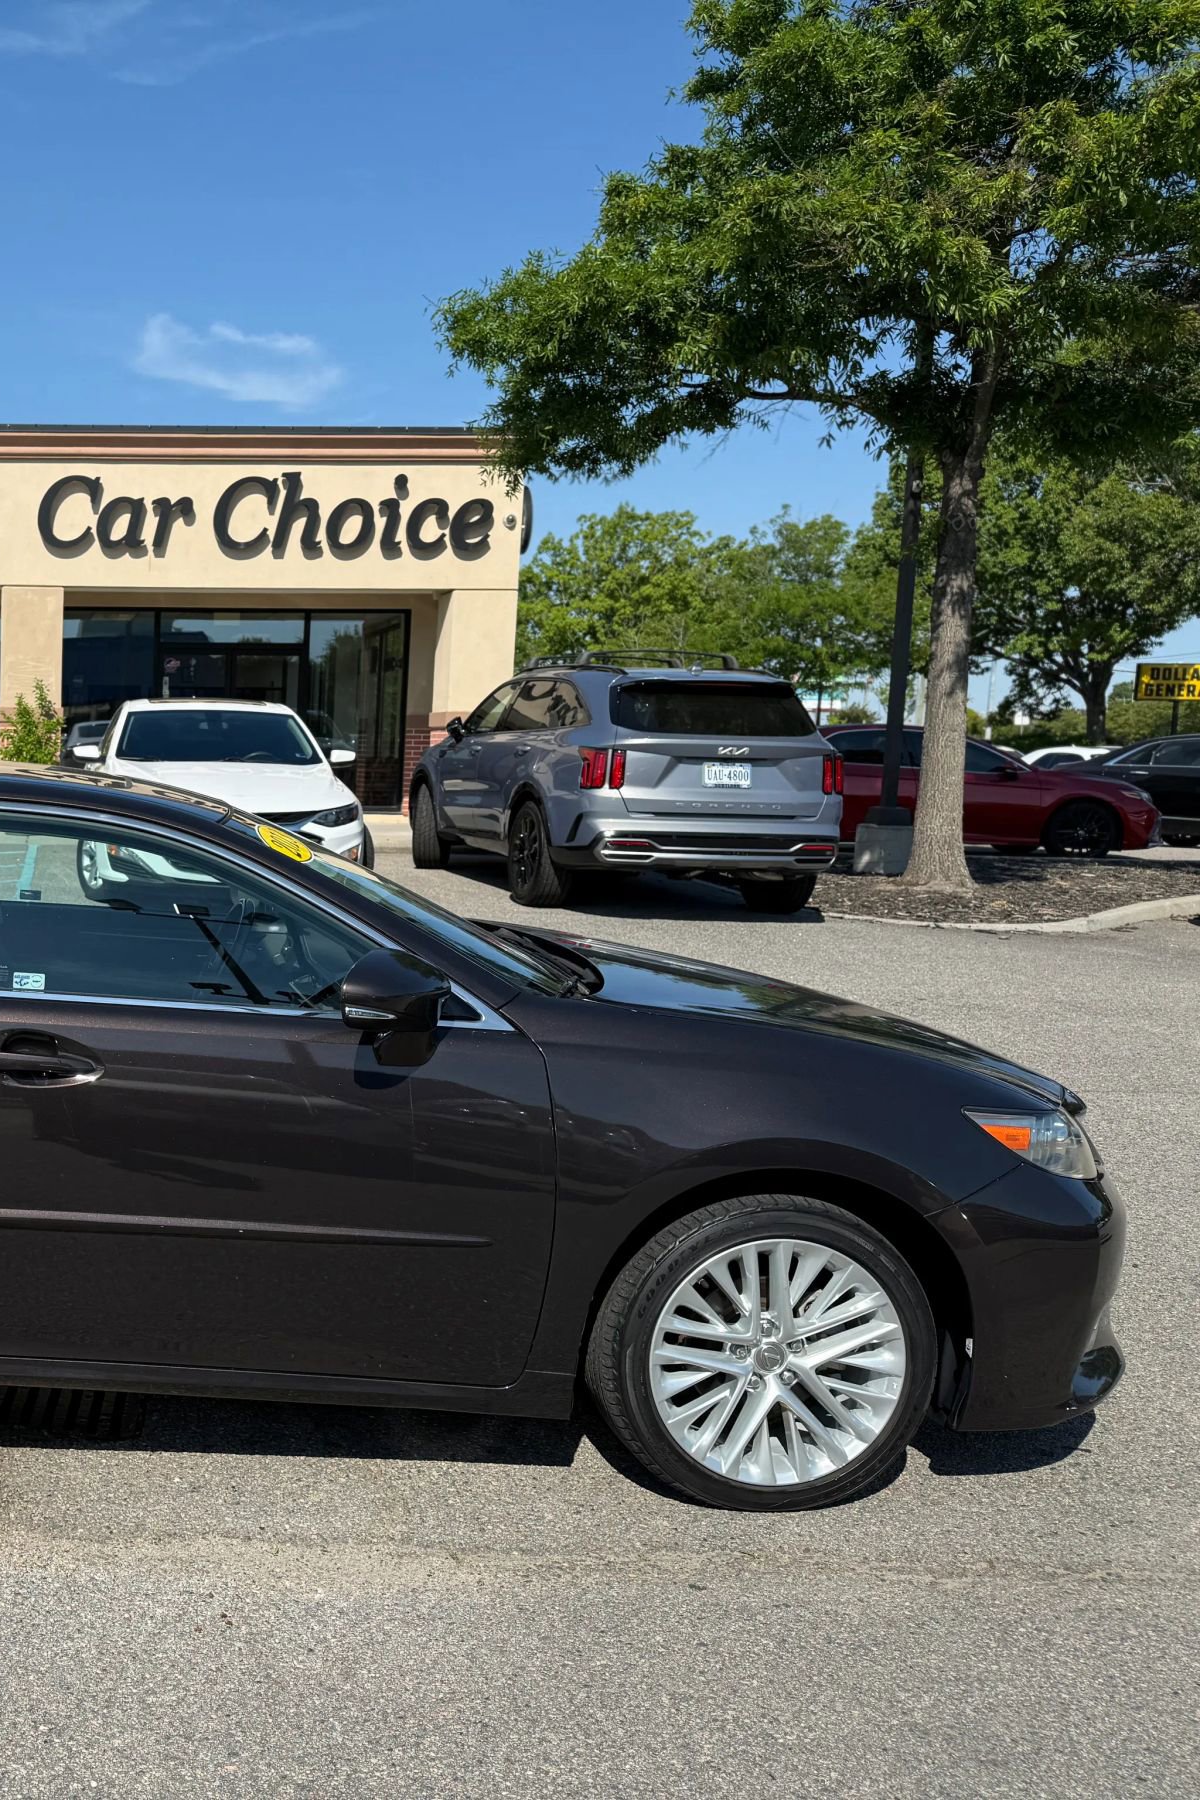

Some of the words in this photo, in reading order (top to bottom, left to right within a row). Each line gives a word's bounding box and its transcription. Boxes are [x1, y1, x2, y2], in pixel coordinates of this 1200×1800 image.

[37, 474, 195, 550] Car
[213, 471, 495, 551] Choice
[1144, 683, 1200, 697] GENER
